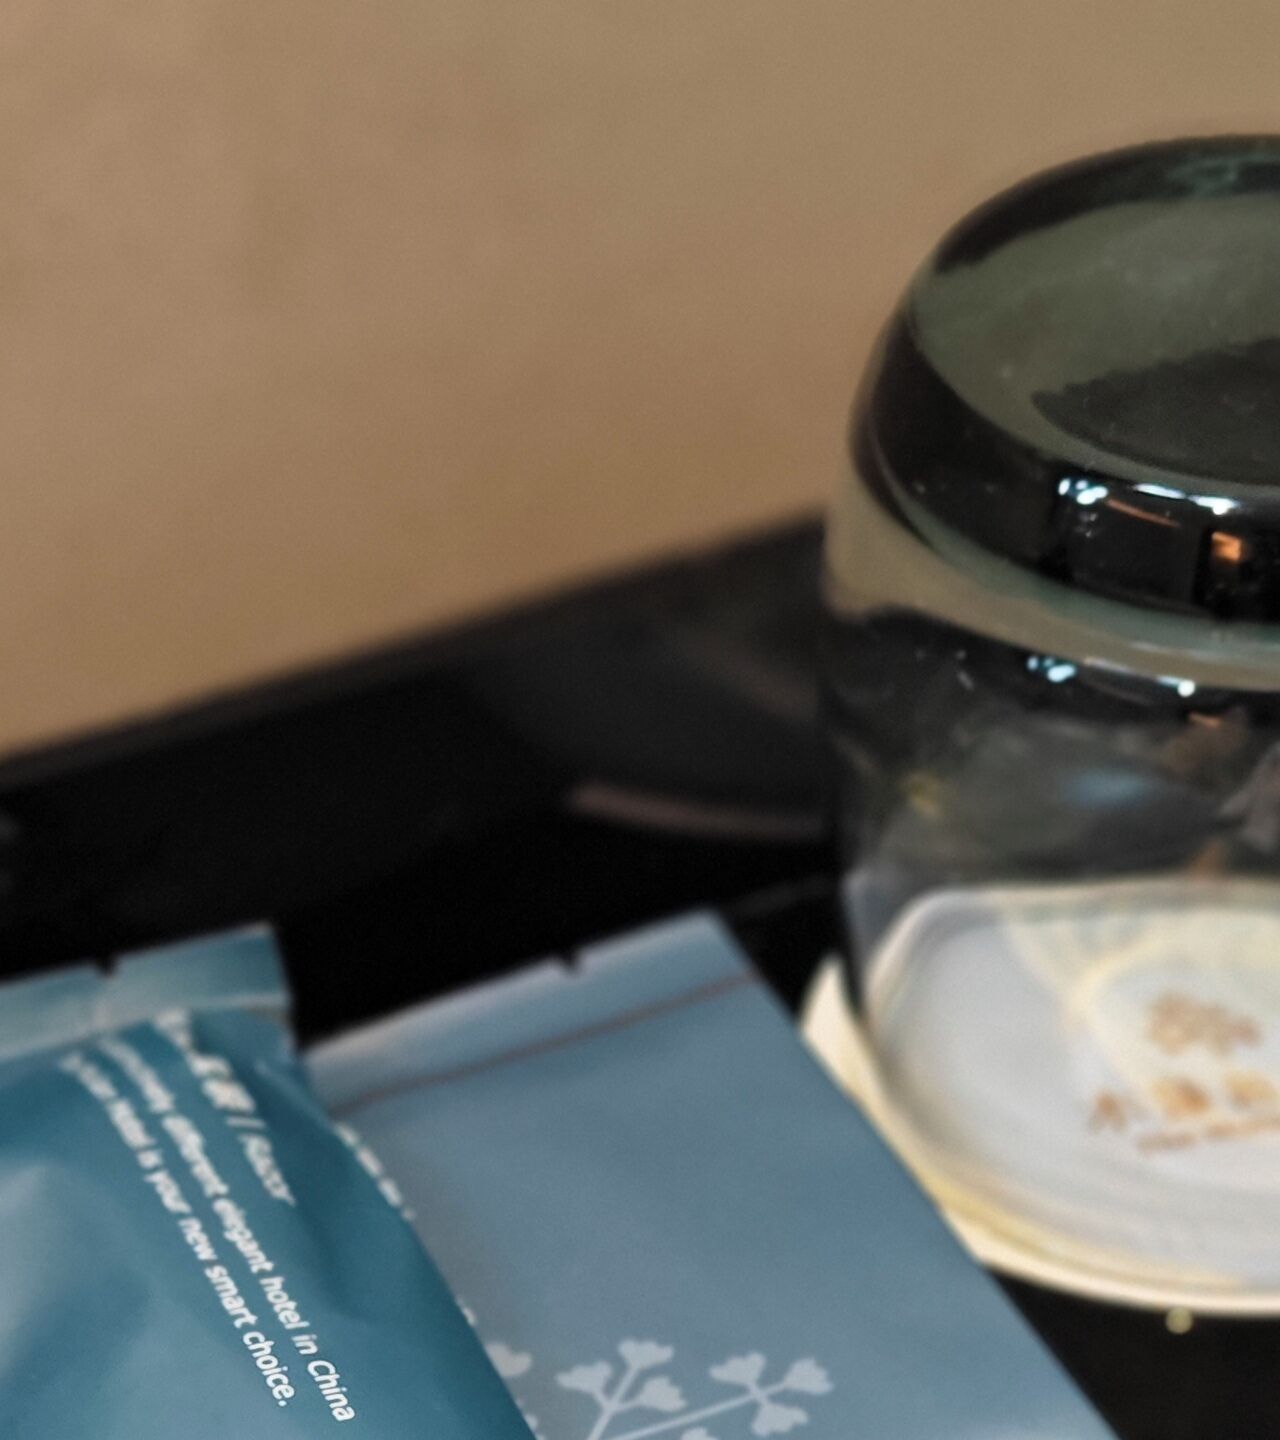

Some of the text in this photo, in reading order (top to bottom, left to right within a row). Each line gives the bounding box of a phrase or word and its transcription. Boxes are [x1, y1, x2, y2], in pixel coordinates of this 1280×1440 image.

[178, 1216, 218, 1262] new
[203, 1263, 259, 1330] smart
[241, 1330, 296, 1408] choice.
[212, 1197, 275, 1275] elegant
[258, 1275, 311, 1331] hotel
[291, 1333, 319, 1356] in
[306, 1358, 355, 1422] China
